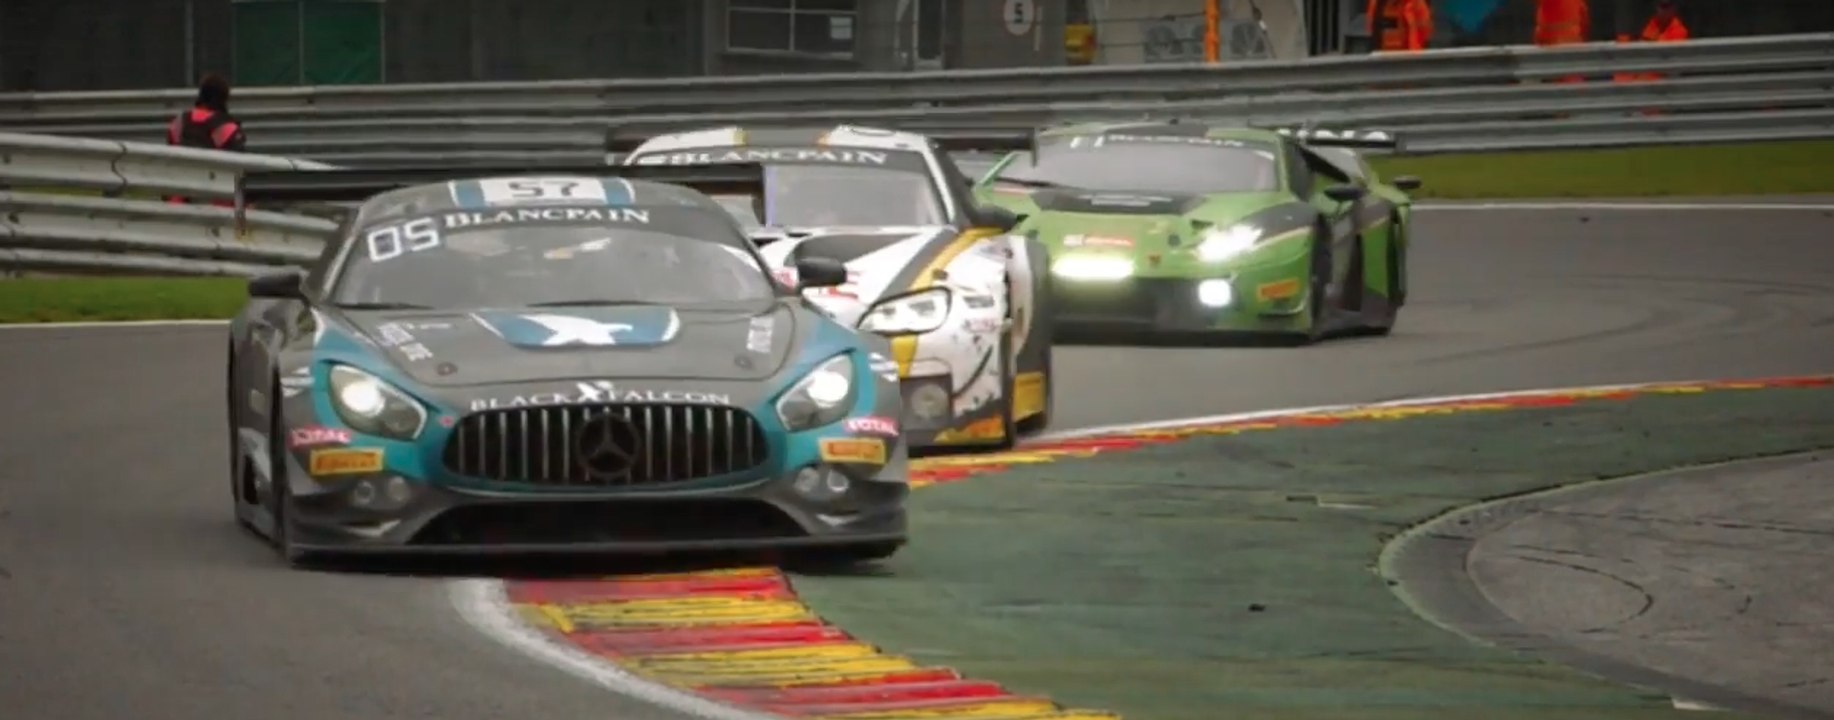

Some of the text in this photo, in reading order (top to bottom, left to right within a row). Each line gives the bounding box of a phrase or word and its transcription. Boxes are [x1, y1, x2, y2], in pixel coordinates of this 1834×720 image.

[508, 181, 580, 198] 57
[444, 207, 650, 229] BLANCPAIN
[470, 388, 730, 412] BLACK FALCON
